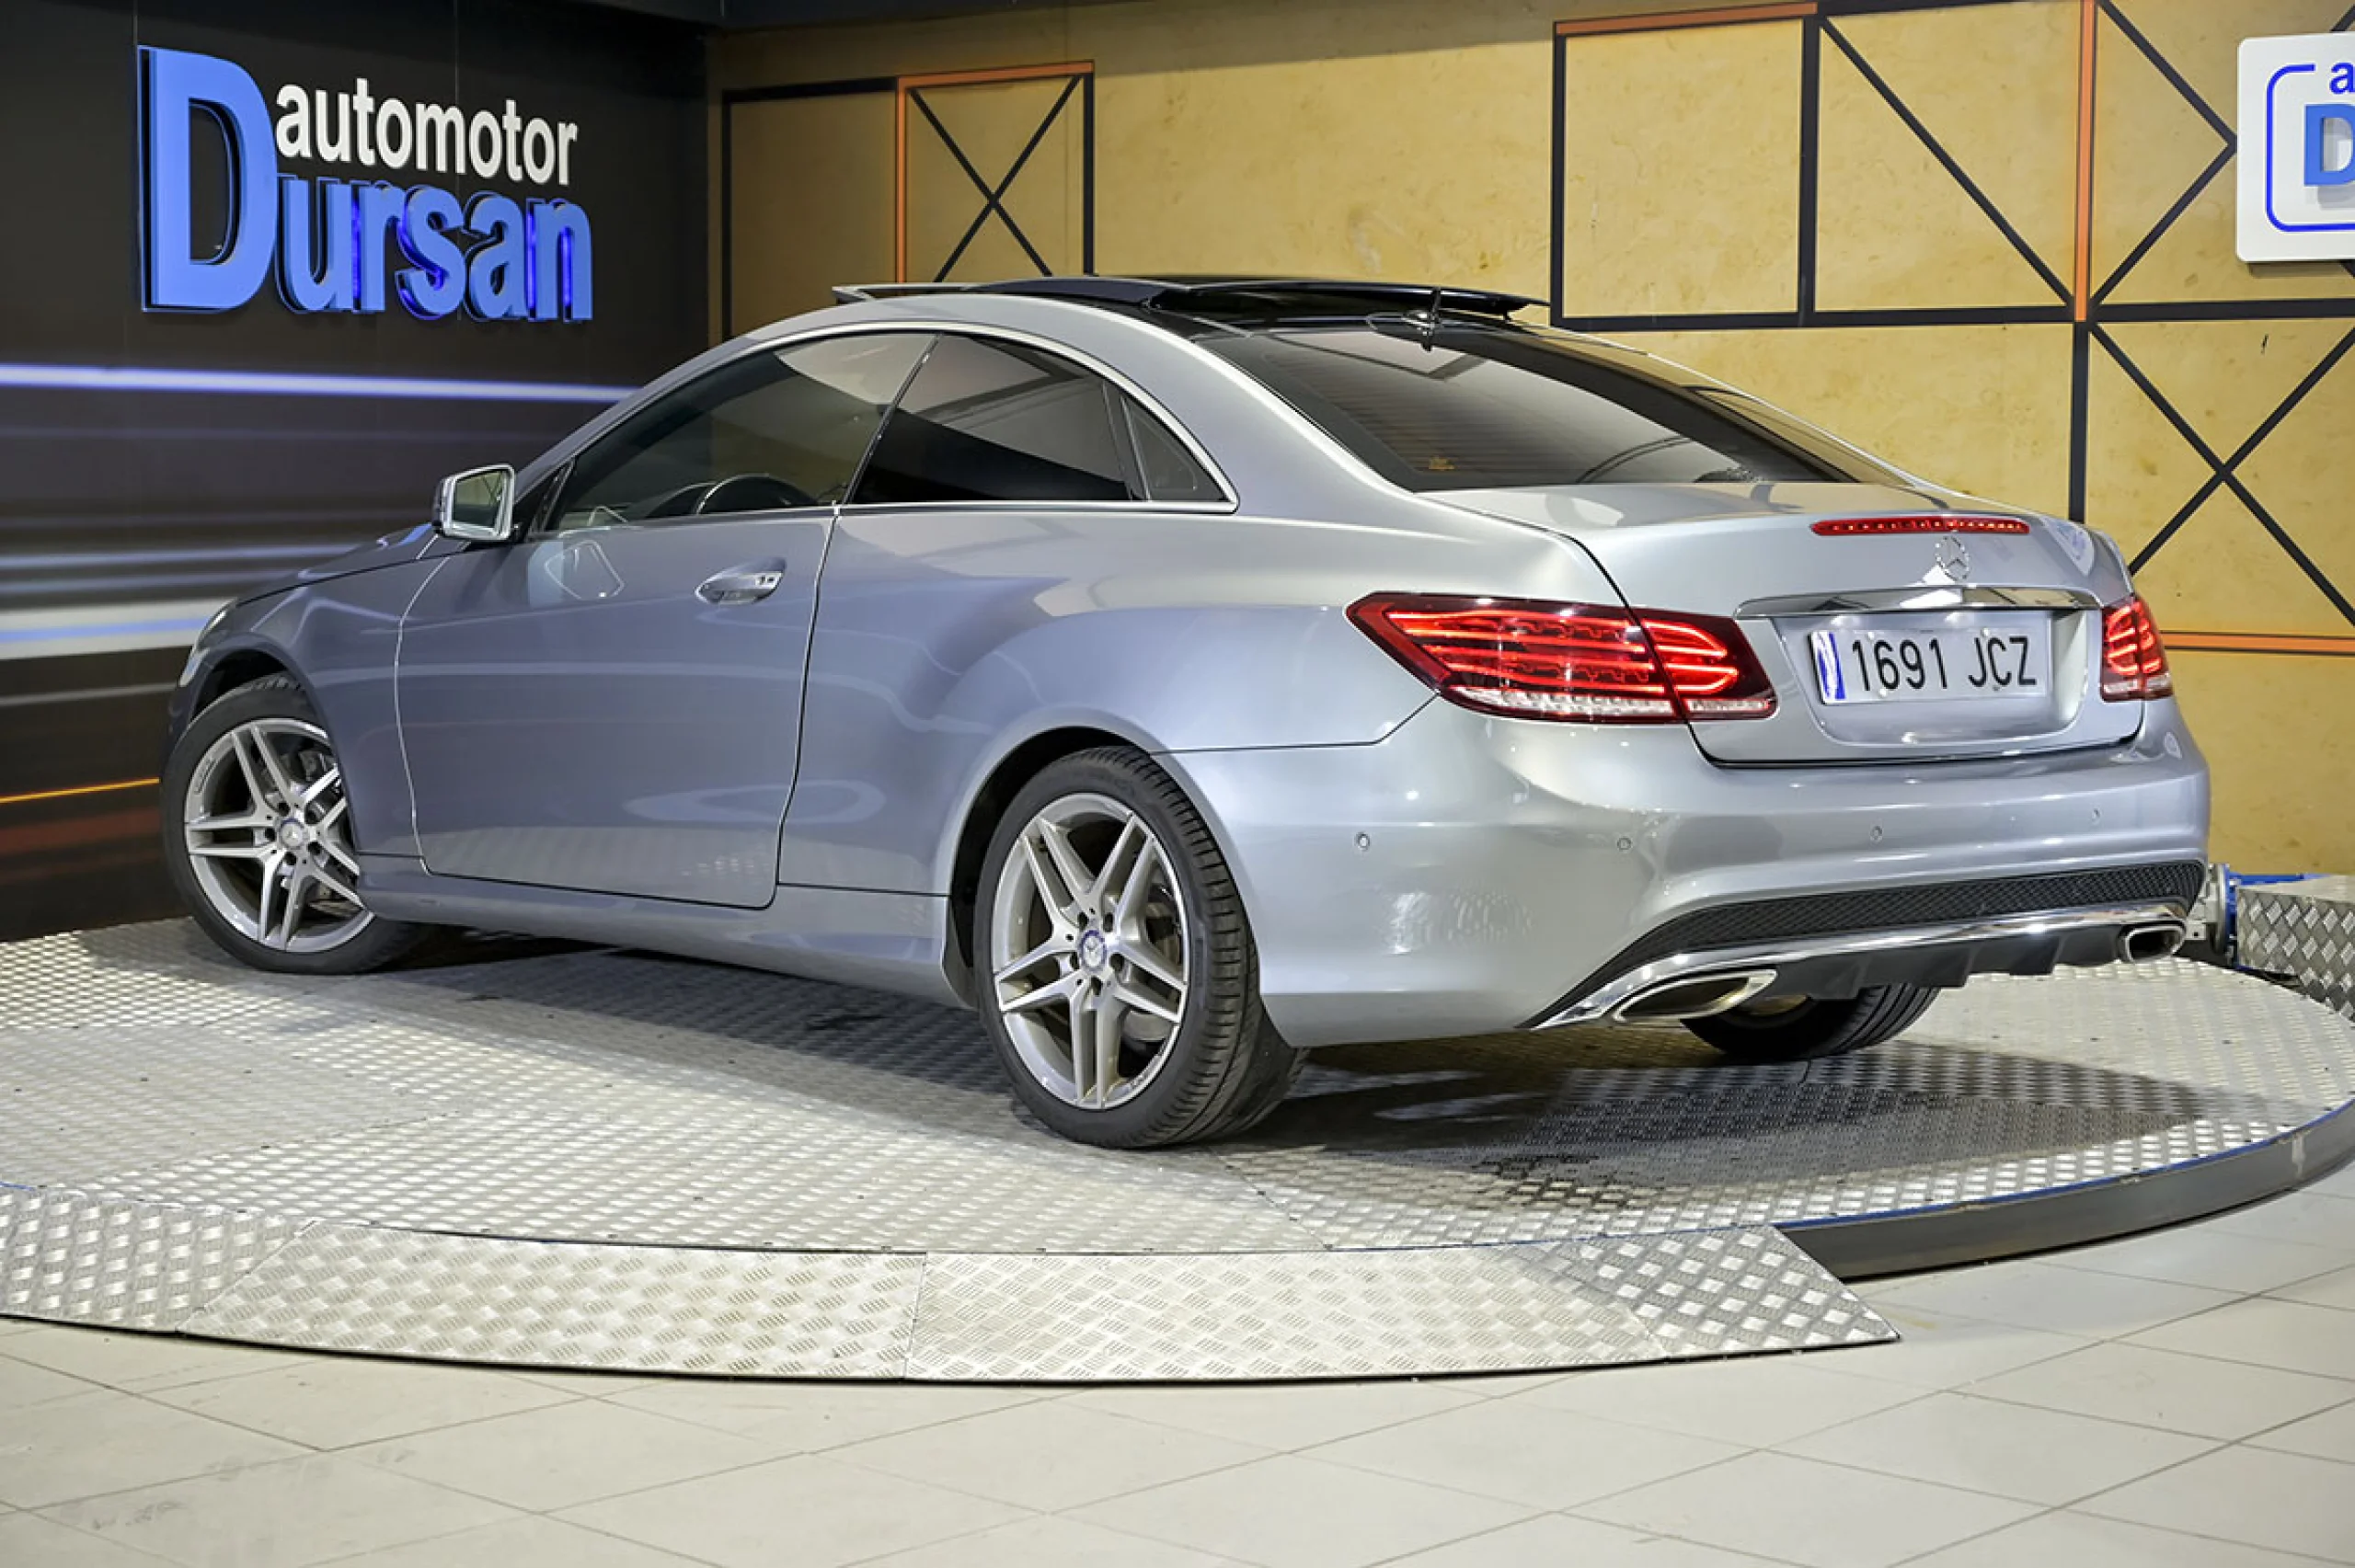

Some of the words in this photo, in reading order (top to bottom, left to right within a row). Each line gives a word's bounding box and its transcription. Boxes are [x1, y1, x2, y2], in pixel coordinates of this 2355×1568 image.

[138, 44, 592, 322] Dursan
[277, 78, 578, 184] automotor
[1852, 638, 1947, 691] 1691
[1968, 635, 2037, 687] JCZ
